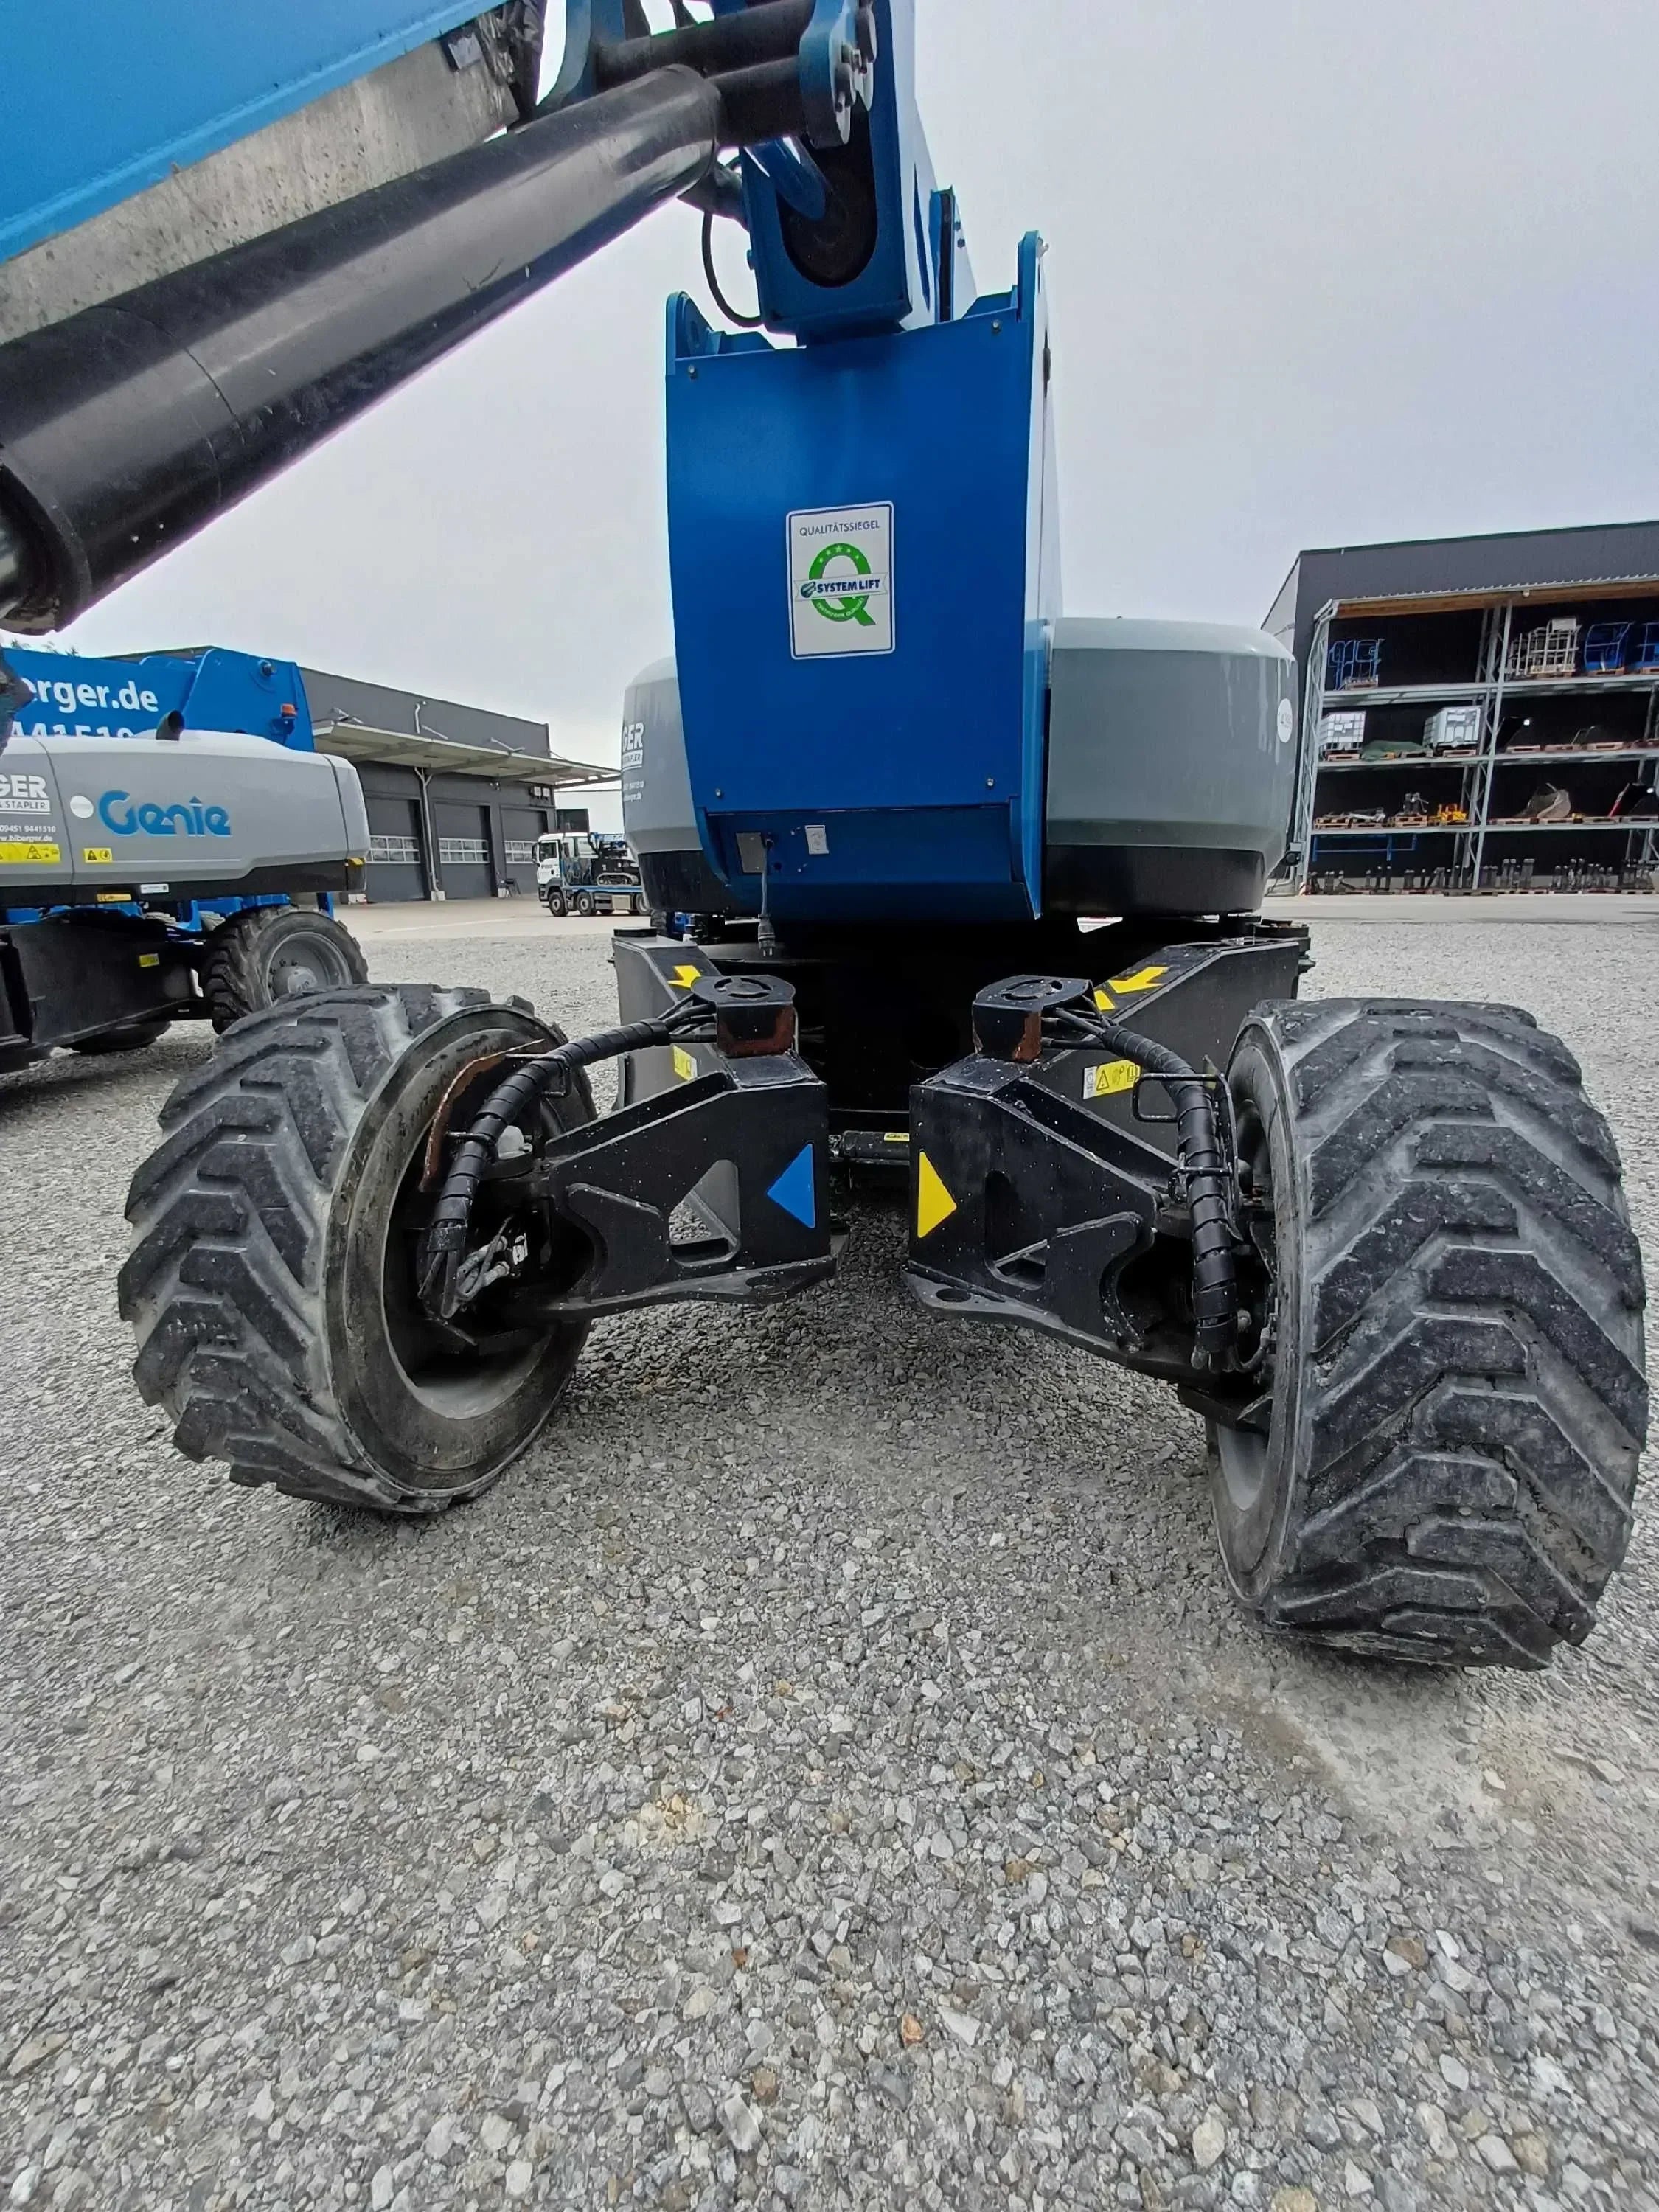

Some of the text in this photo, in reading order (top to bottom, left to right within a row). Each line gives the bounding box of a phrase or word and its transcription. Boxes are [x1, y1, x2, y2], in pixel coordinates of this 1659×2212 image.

[799, 520, 880, 537] QUALITÄTSSIEGEL
[817, 579, 880, 594] SYSTEM LIFT
[99, 790, 231, 835] Genie
